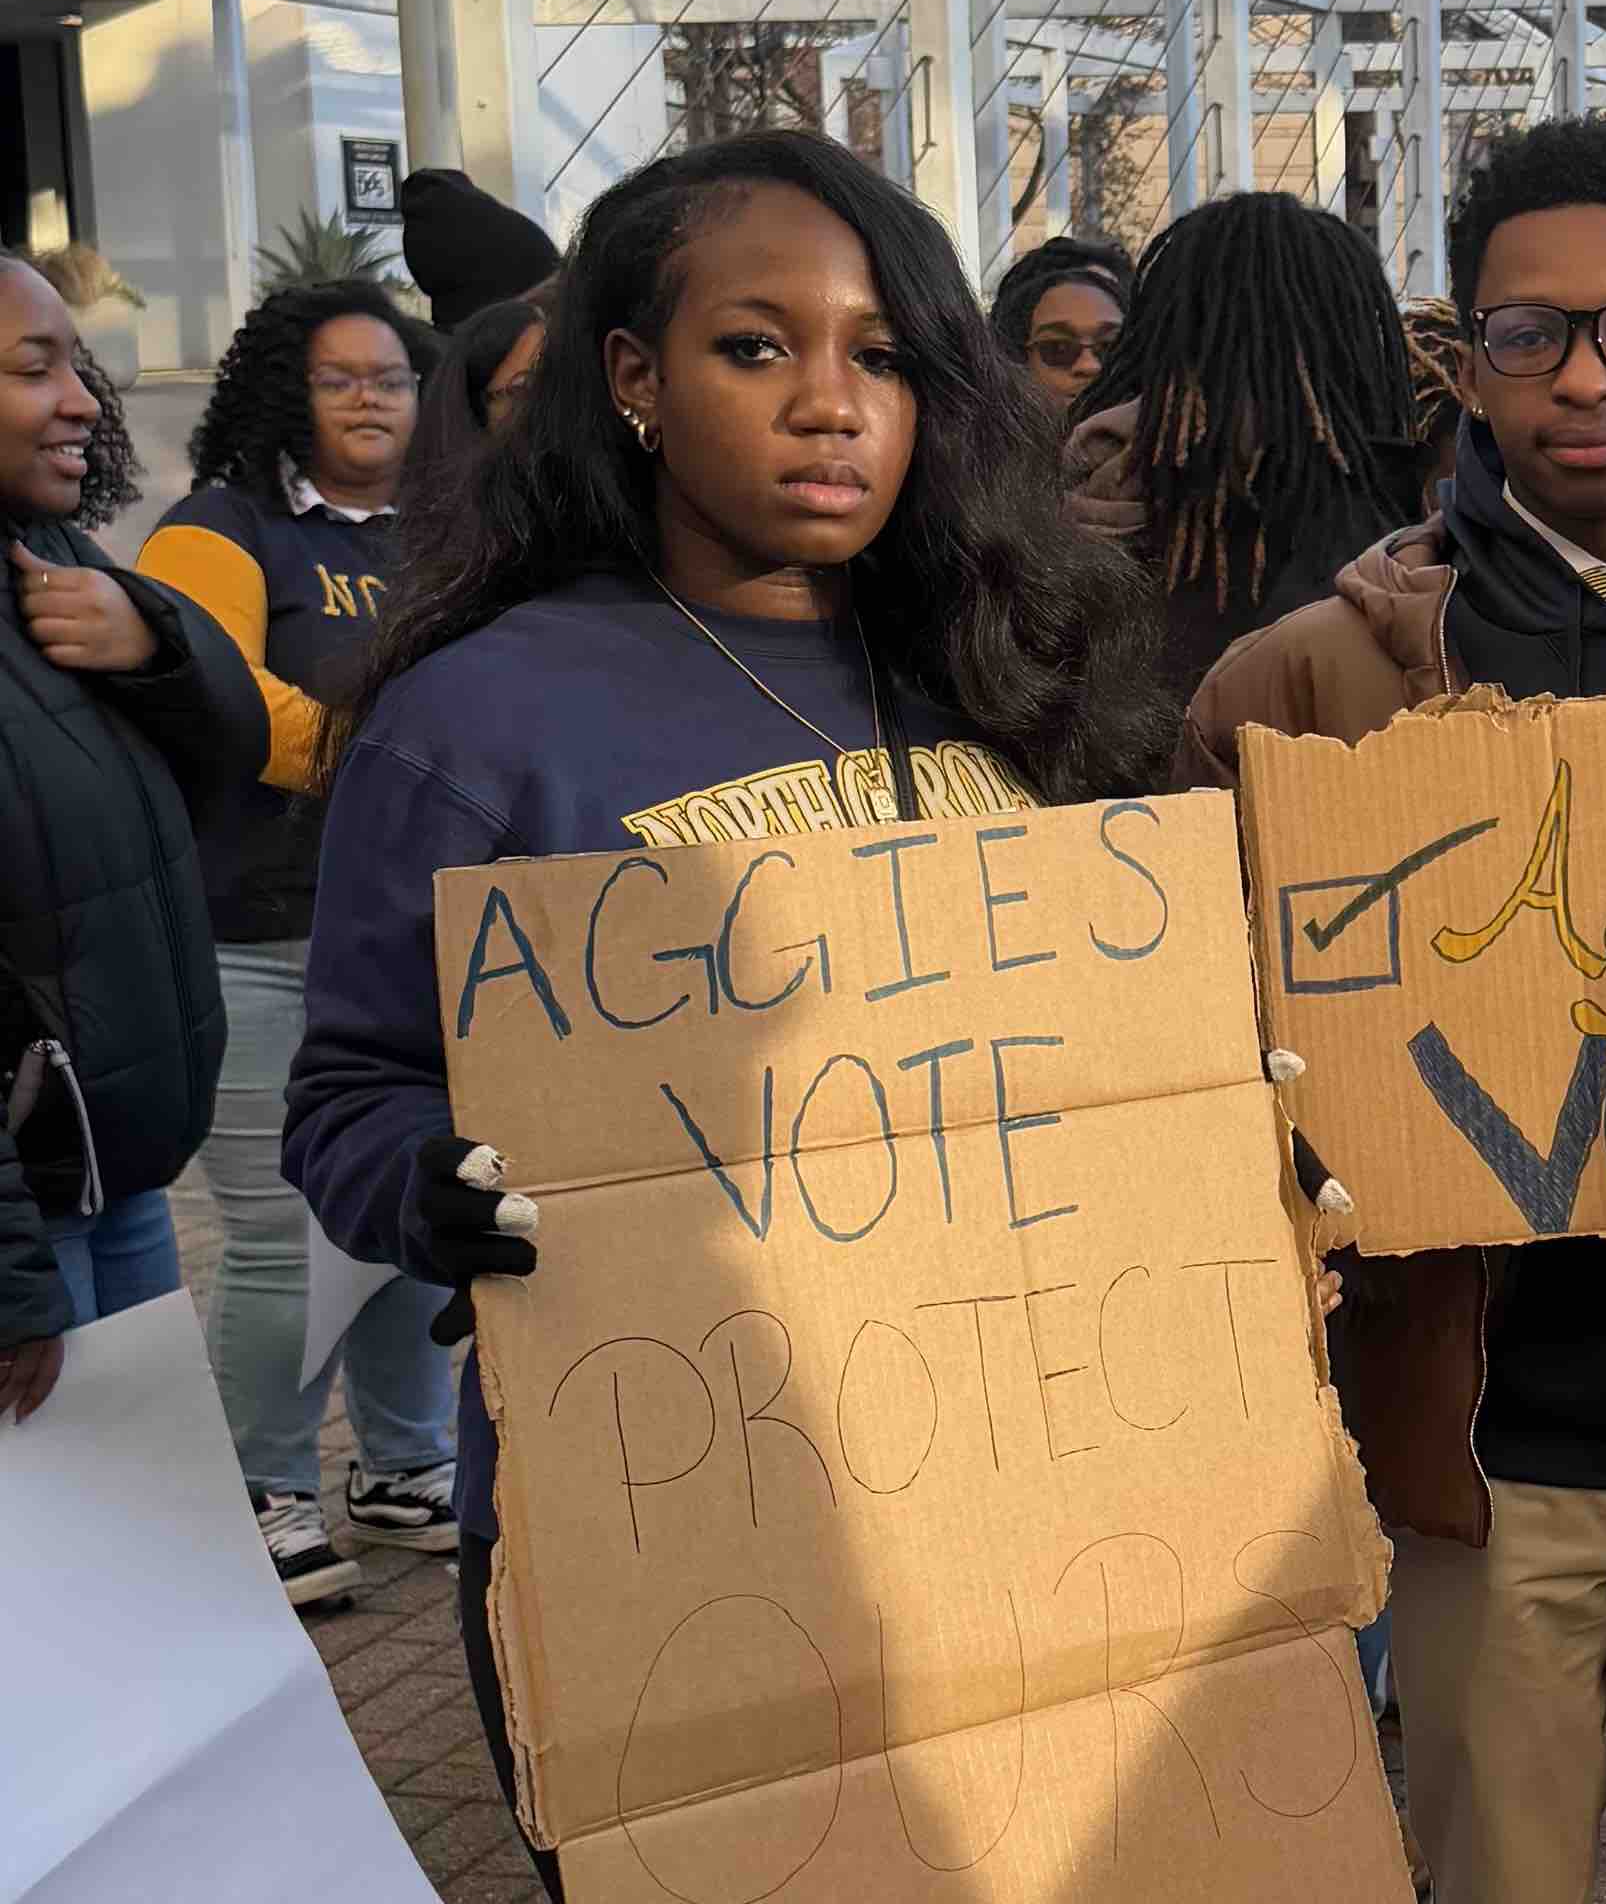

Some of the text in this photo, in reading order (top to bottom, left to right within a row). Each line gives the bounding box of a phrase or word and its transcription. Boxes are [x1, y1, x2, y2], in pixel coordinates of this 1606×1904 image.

[456, 801, 1170, 1040] AGGIES
[660, 1035, 1080, 1243] VOTE
[548, 1258, 1278, 1554] PROTECT
